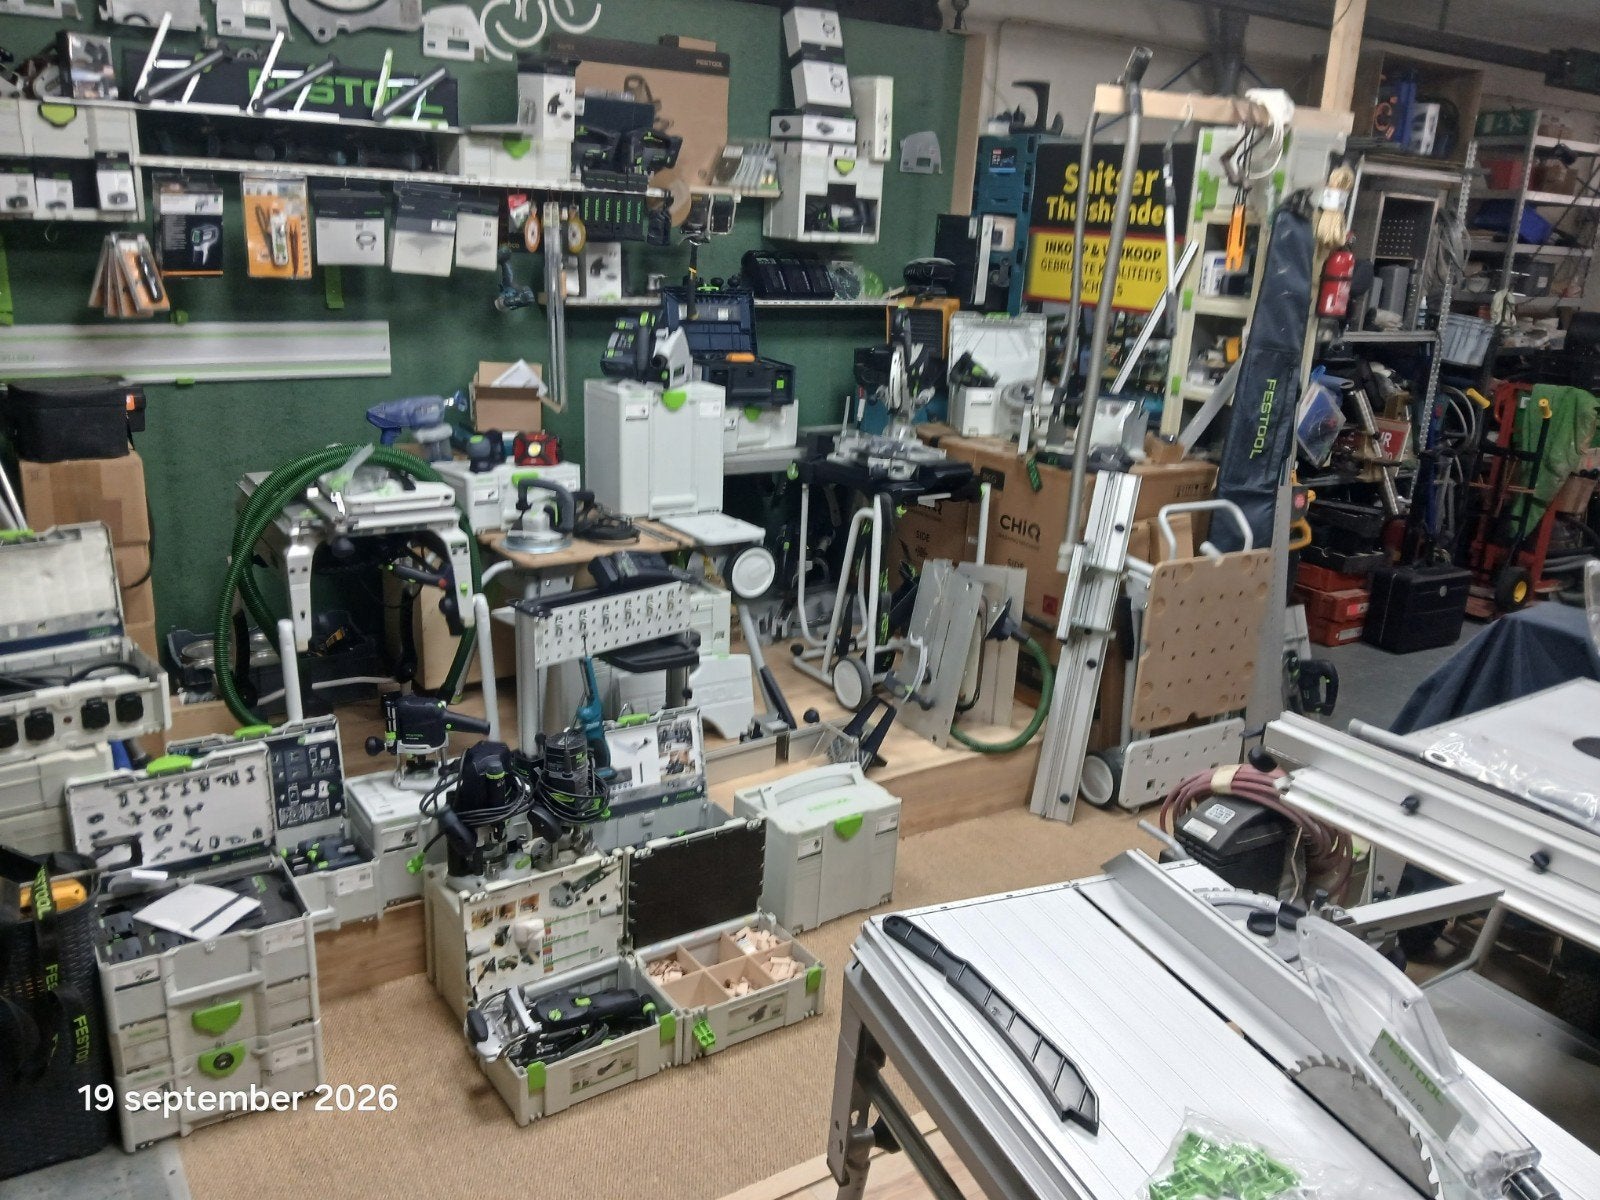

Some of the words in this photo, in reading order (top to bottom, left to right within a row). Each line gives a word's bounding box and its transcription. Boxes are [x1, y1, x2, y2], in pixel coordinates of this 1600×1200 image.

[1045, 239, 1090, 257] INKOP
[1101, 246, 1162, 263] VKOOP
[1249, 378, 1278, 460] FESTOOL
